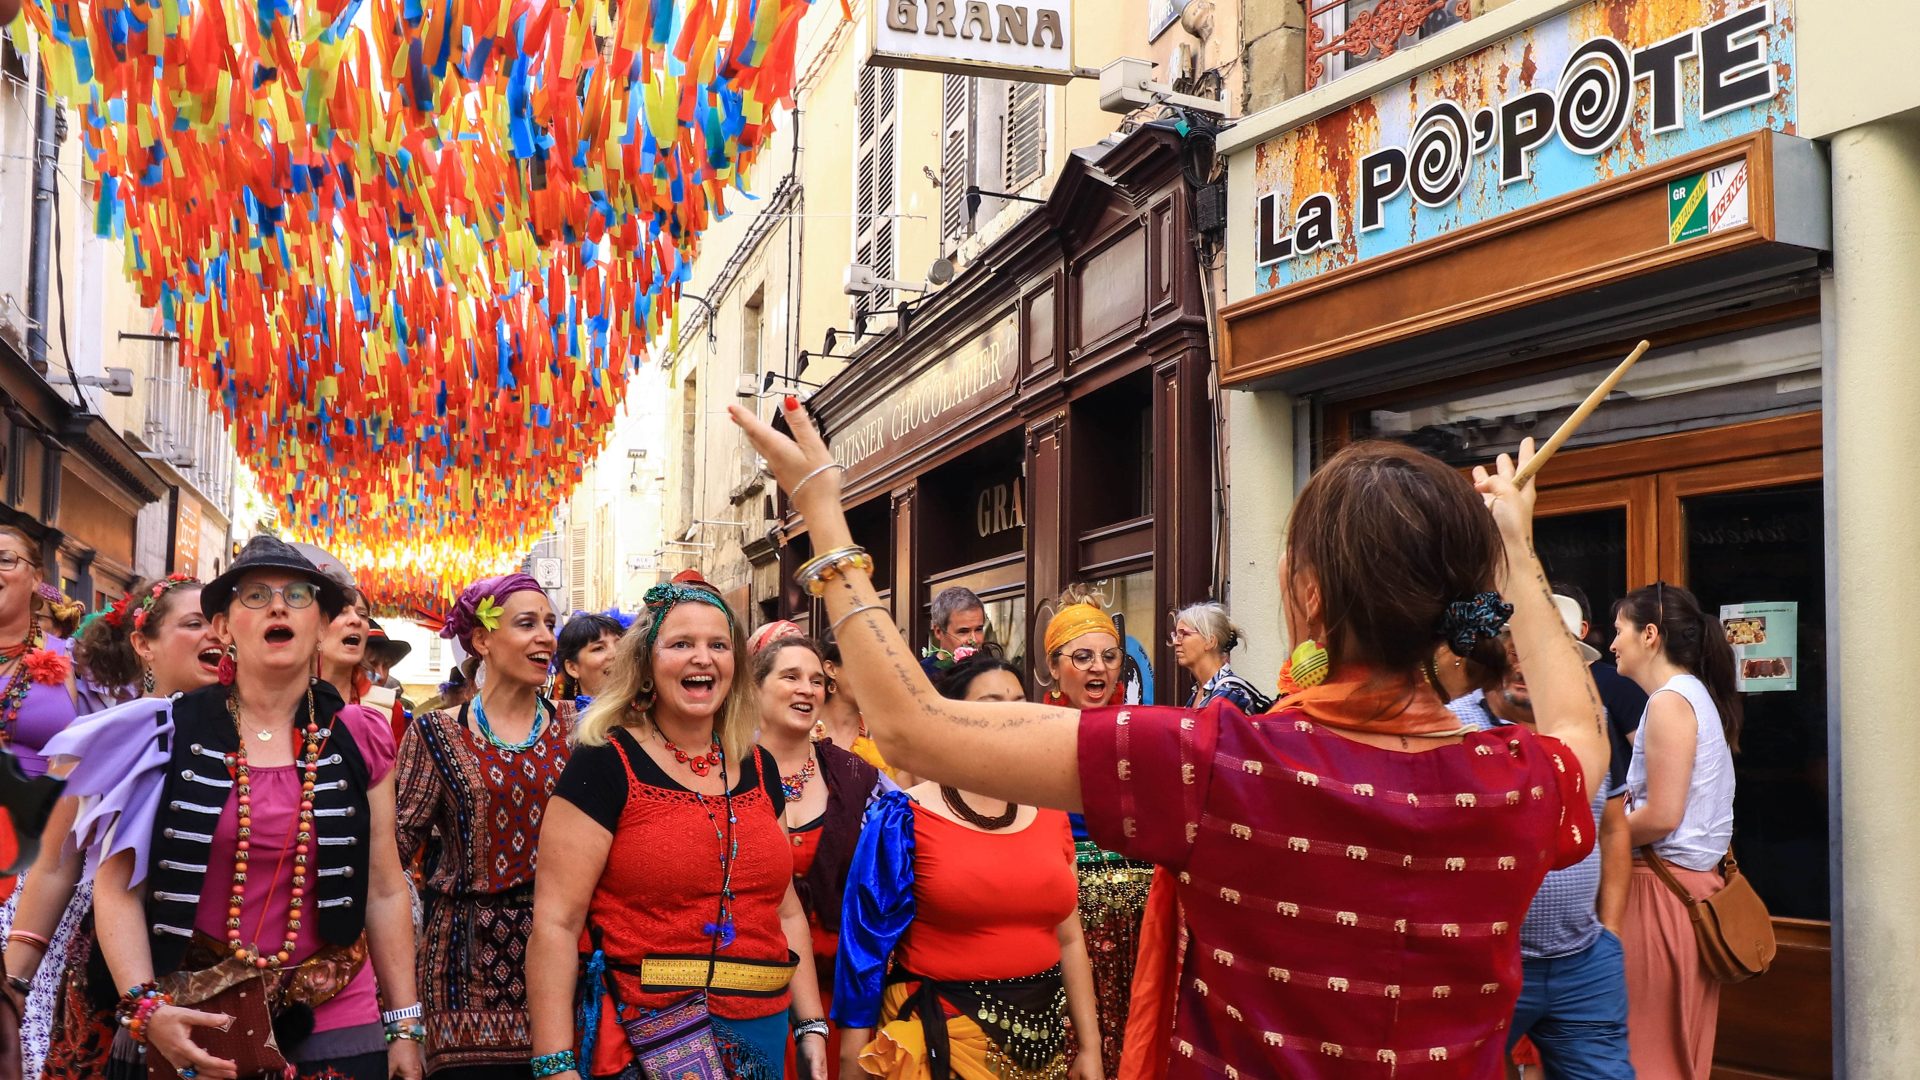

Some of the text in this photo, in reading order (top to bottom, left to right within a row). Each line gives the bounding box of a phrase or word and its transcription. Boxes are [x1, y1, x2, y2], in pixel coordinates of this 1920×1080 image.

[887, 0, 1064, 49] GRANA
[1671, 175, 1708, 238] RESTAURANT
[1672, 187, 1686, 200] GR
[1711, 168, 1726, 188] IV
[1711, 163, 1748, 227] LICENCE
[1258, 190, 1338, 267] La
[891, 341, 1002, 441] CHOCOLATIER
